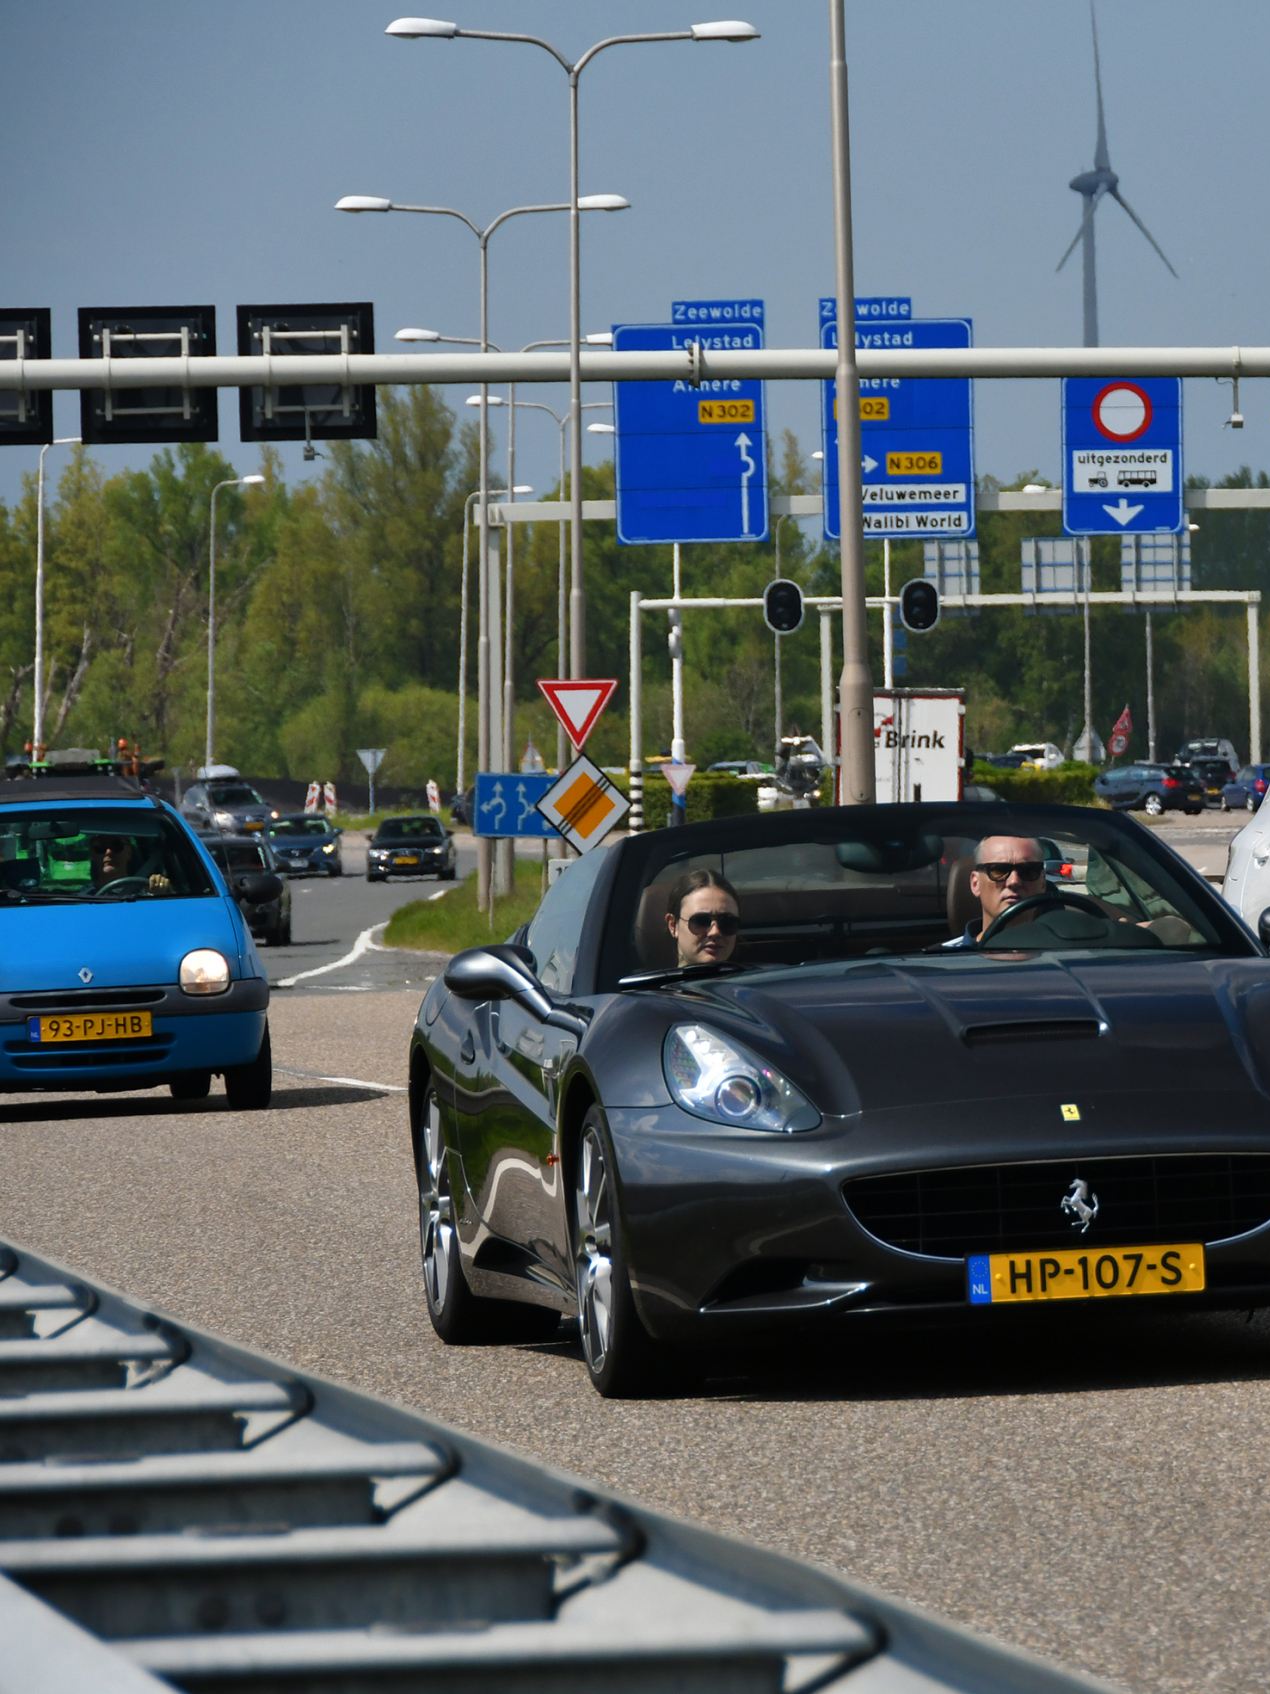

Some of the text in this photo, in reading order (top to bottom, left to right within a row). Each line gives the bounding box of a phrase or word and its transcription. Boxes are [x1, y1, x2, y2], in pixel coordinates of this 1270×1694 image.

[673, 303, 762, 319] Zeewolde
[821, 301, 909, 317] Zwolde
[831, 331, 913, 348] Llystad
[1077, 452, 1168, 467] uitgezonderd
[915, 514, 962, 528] World
[885, 730, 945, 749] Brink
[48, 1016, 143, 1038] 93-PJ-HB
[972, 1251, 1183, 1295] NL HP-107-S
